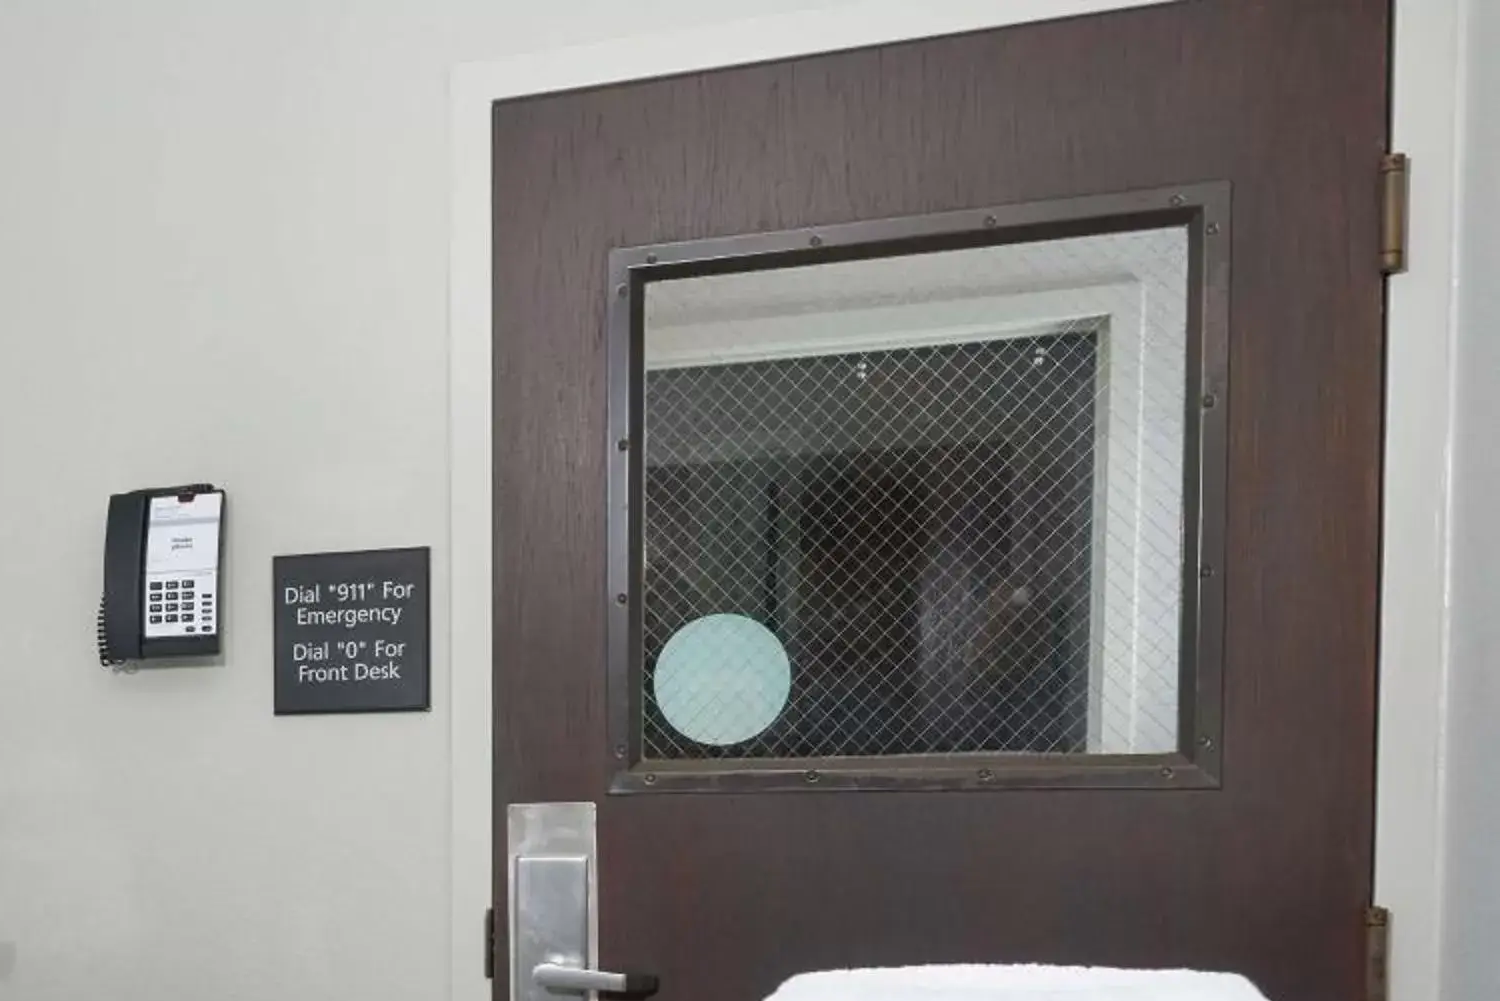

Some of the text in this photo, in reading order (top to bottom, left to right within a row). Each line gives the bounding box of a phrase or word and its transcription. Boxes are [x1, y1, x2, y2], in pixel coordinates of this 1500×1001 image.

[284, 581, 415, 604] Dial "911" For
[297, 607, 402, 627] Emergency
[293, 639, 406, 661] Dial "0" For
[299, 661, 400, 682] Front Desk
